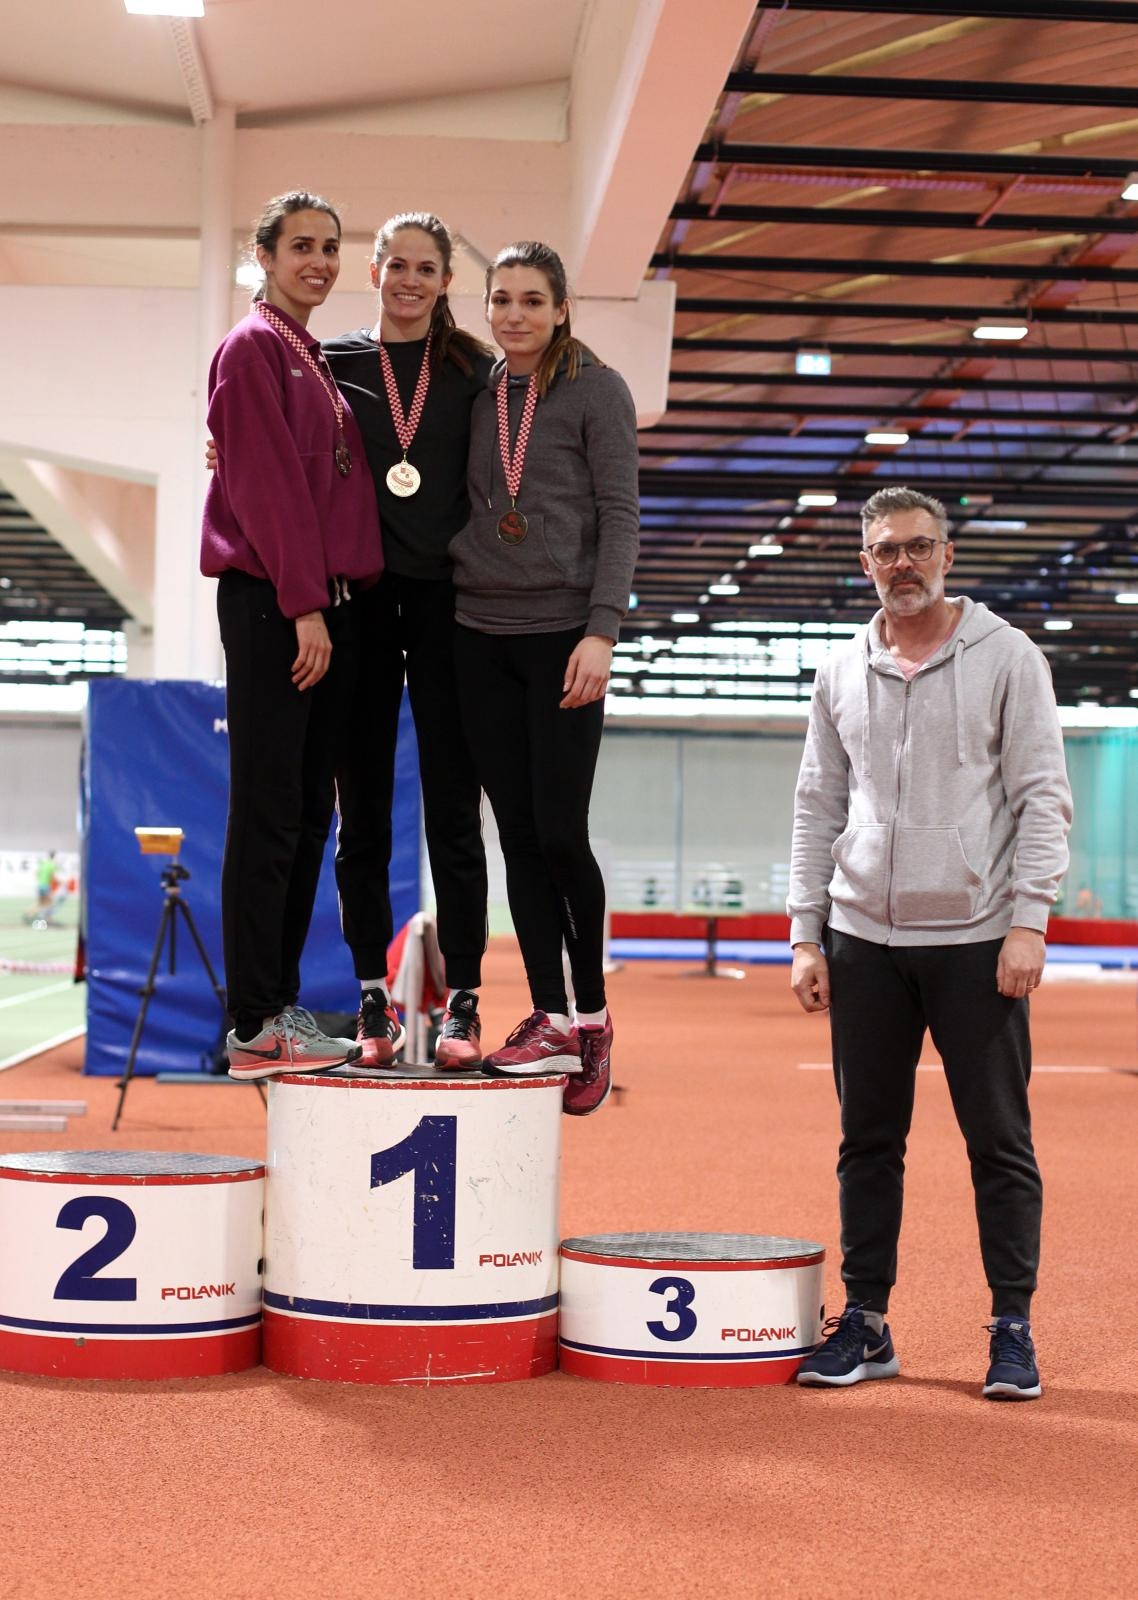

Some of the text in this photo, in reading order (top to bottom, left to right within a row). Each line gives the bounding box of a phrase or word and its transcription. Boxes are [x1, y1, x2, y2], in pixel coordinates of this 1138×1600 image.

[370, 1115, 457, 1269] 1
[54, 1196, 137, 1301] 2
[479, 1250, 543, 1267] POLANIK
[161, 1282, 236, 1300] POLANIK
[646, 1276, 697, 1341] 3
[721, 1326, 797, 1342] POLANIK
